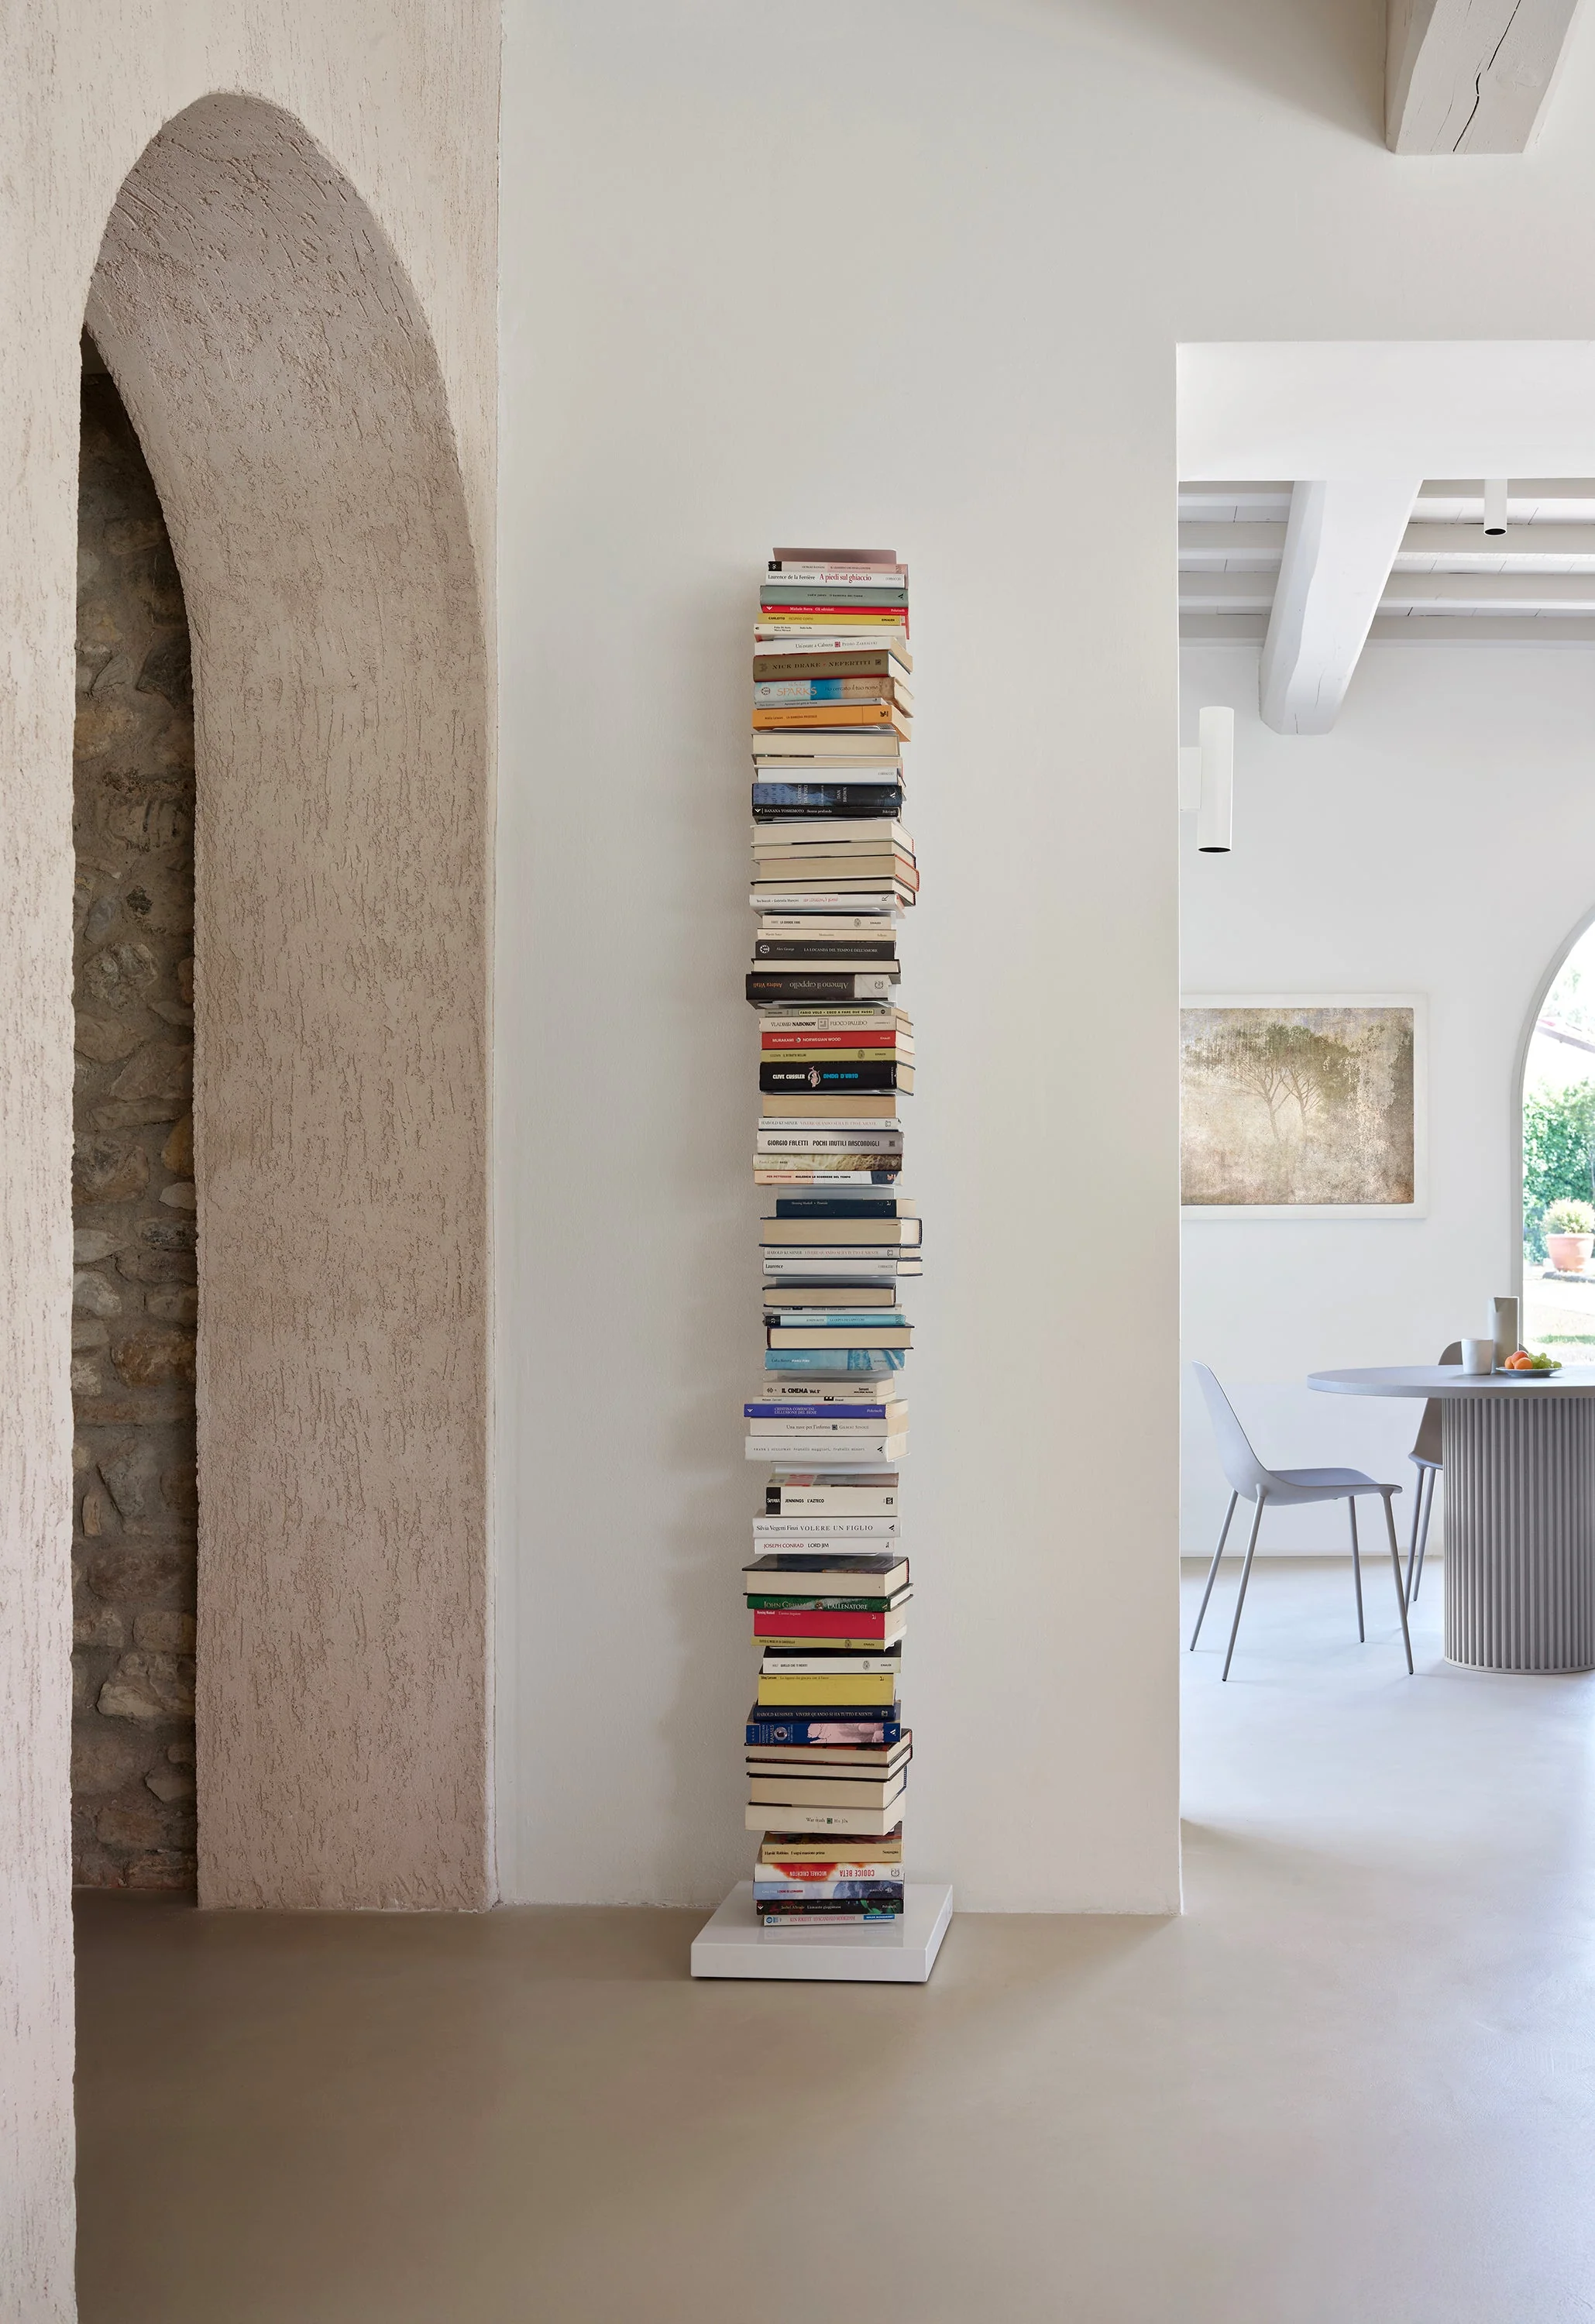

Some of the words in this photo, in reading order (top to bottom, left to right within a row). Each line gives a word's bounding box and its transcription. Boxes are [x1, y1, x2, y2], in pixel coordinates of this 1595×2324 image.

[825, 574, 839, 583] piedi
[849, 574, 871, 583] ghiaccio
[776, 686, 817, 696] SPARKS
[789, 980, 816, 989] cappello
